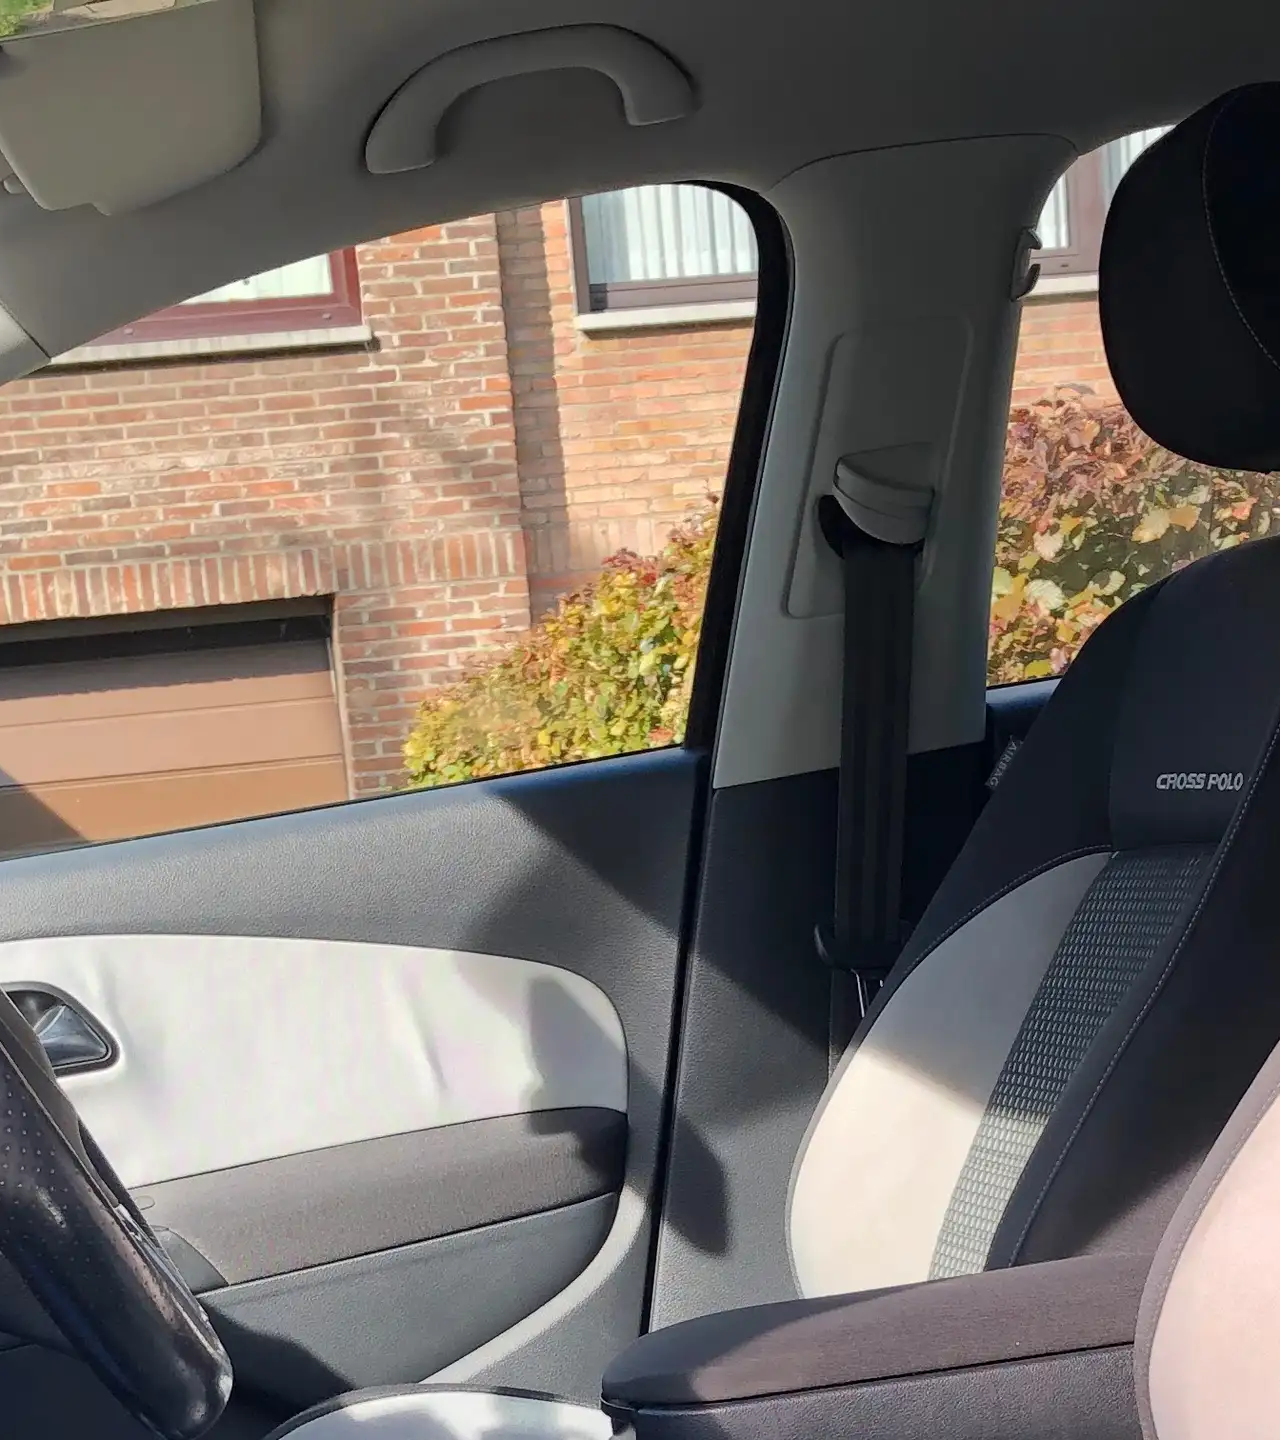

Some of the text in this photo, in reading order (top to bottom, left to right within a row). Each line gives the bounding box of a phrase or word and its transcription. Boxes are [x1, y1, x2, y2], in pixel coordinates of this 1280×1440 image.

[989, 740, 1018, 788] AIRBAG
[1155, 772, 1244, 791] CROSS POLO
